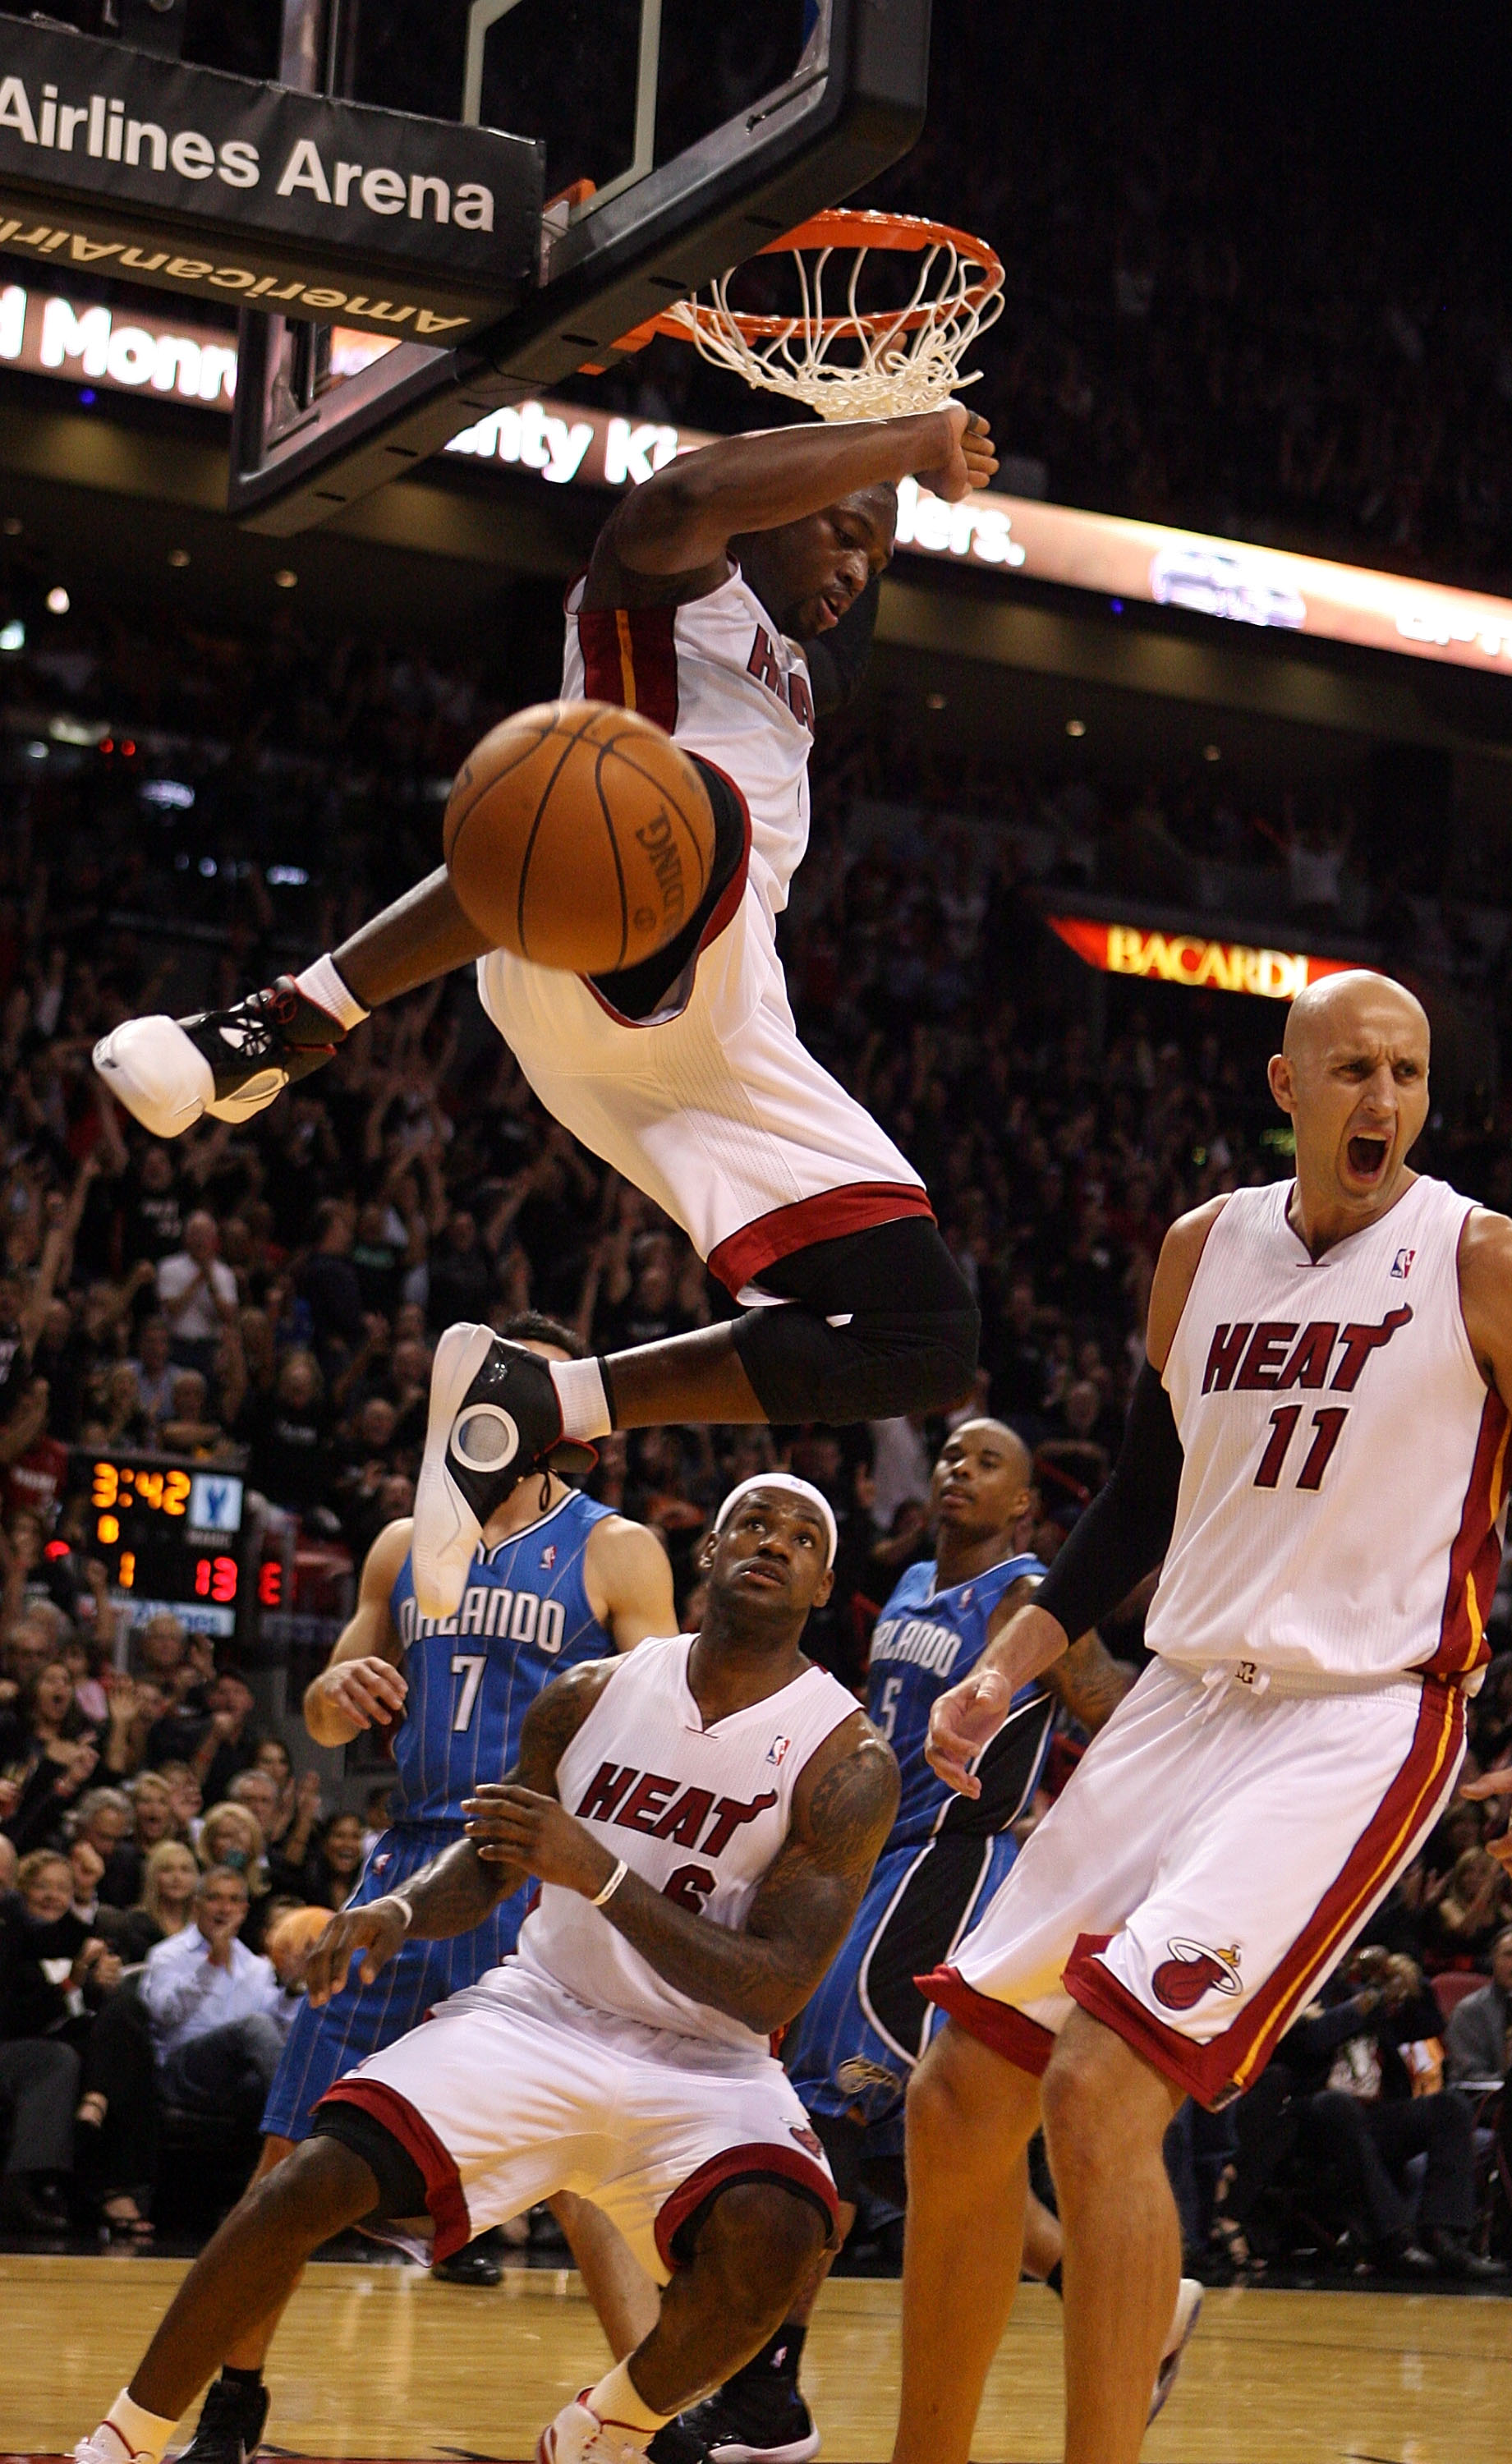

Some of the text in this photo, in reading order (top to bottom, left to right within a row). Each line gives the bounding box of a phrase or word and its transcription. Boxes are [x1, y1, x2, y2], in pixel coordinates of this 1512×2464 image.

[0, 76, 494, 232] Airlines Arena
[0, 217, 472, 334] AmericanAirl
[1108, 923, 1308, 1001] BACARDI
[1201, 1302, 1413, 1395] HEAT
[1252, 1403, 1353, 1492] 11
[91, 1463, 191, 1516] 3:42
[195, 1556, 238, 1602] 13
[871, 1619, 963, 1679] RLANDO
[451, 1653, 488, 1733] 7
[879, 1678, 903, 1741] 5
[575, 1762, 779, 1858] HEAT
[661, 1862, 721, 1917] 6
